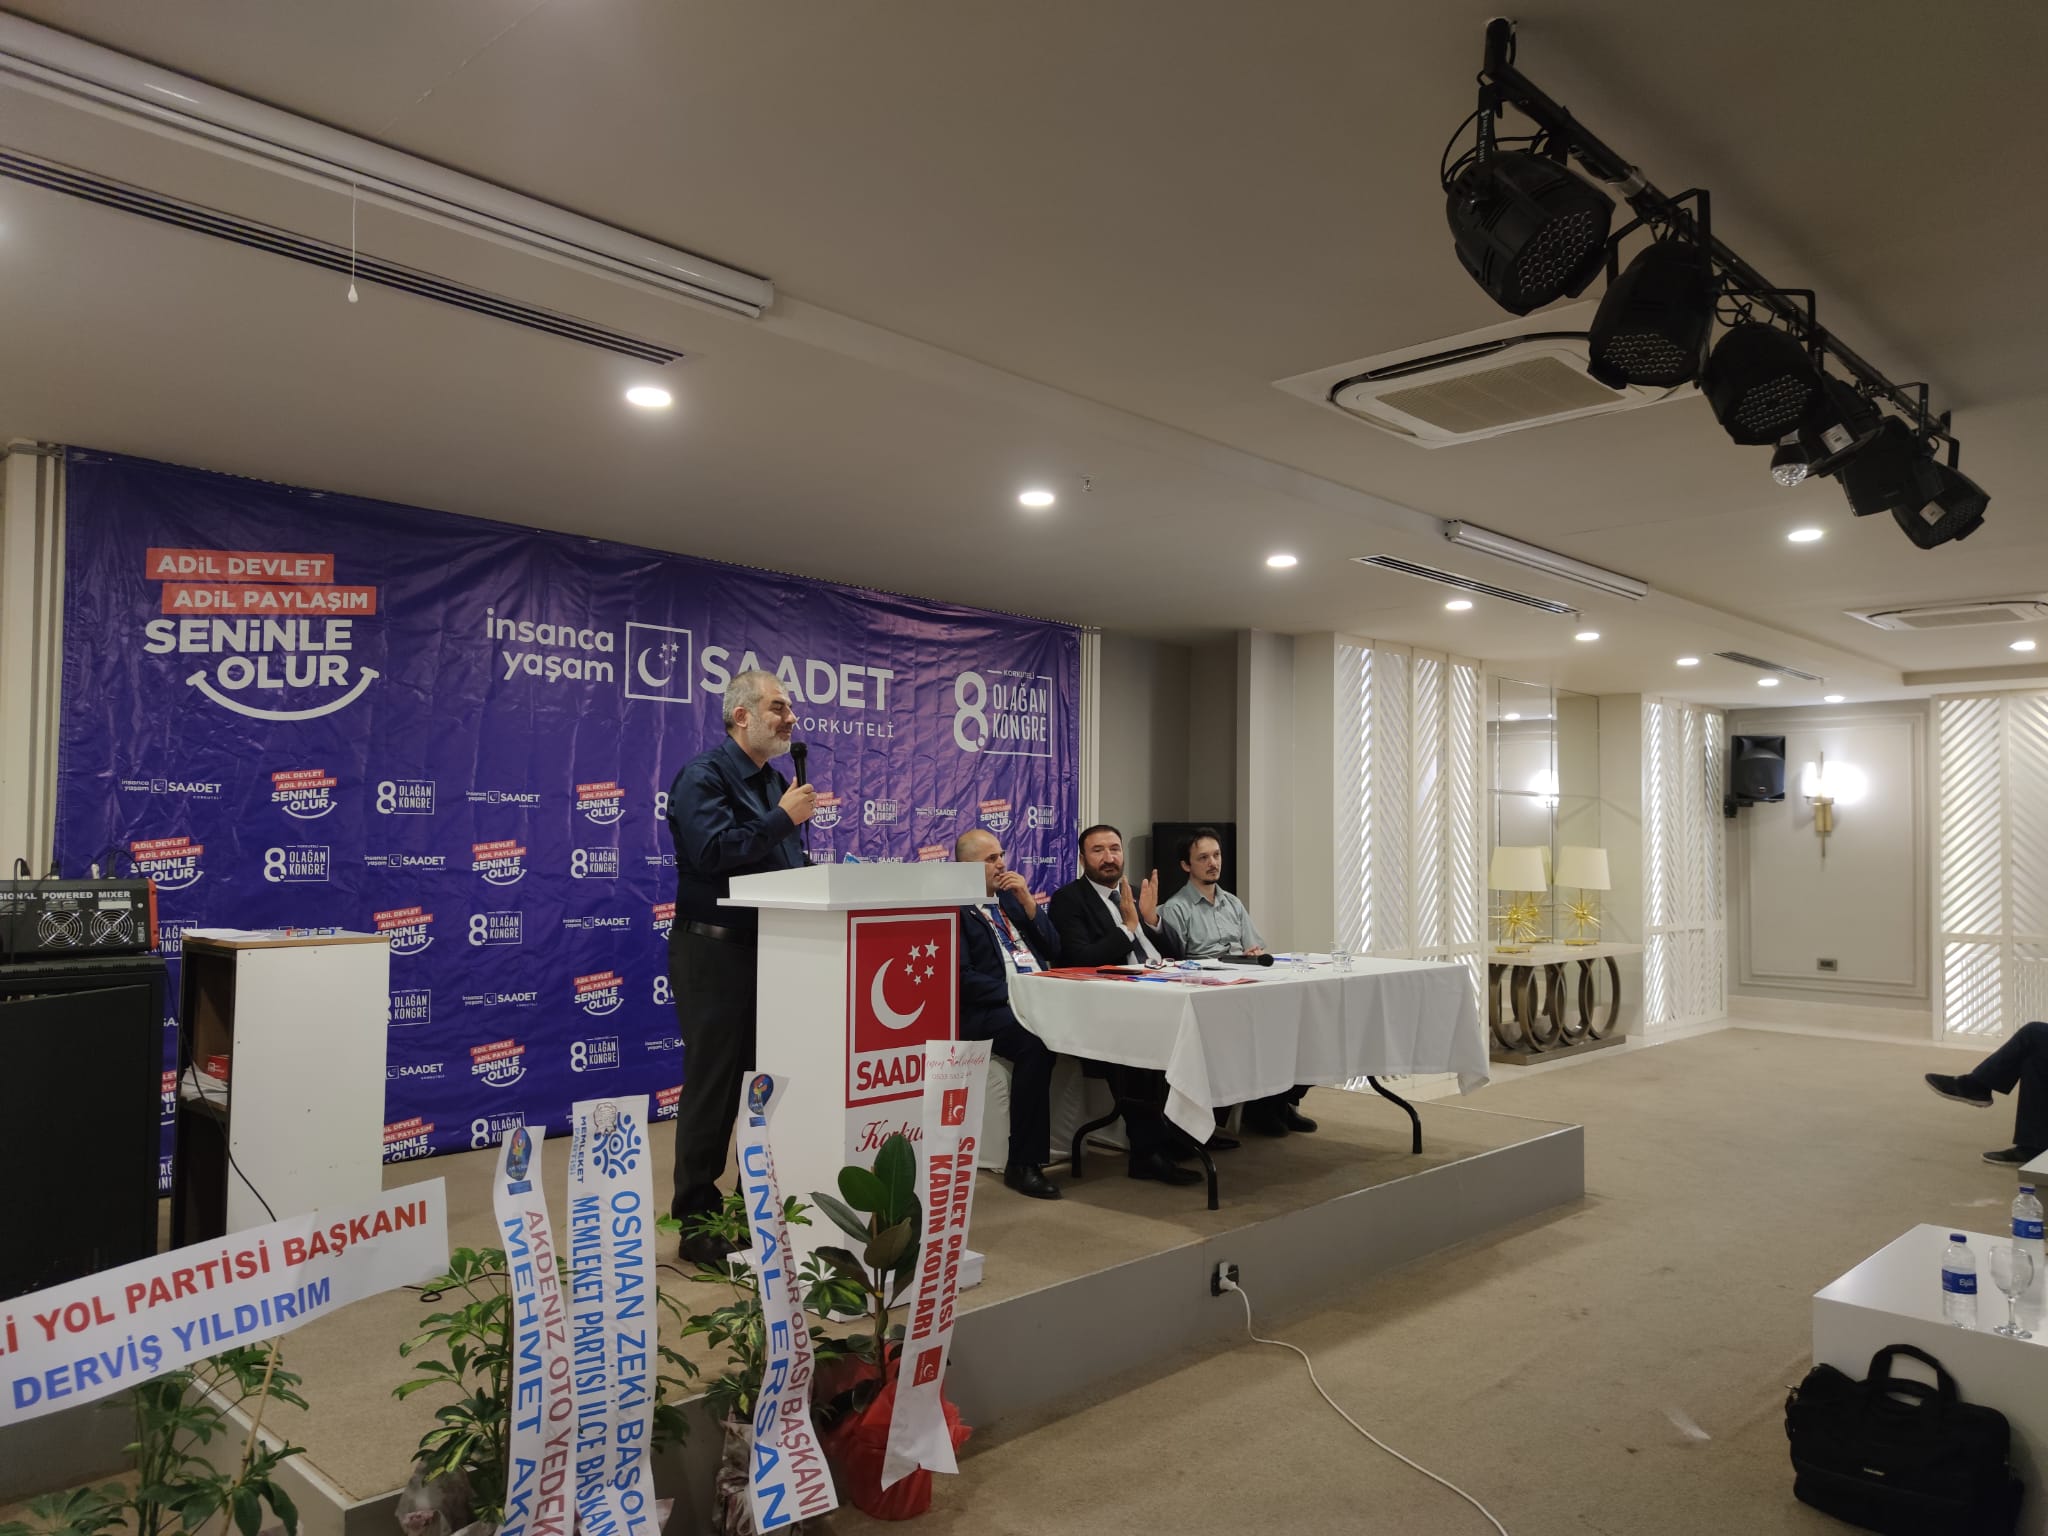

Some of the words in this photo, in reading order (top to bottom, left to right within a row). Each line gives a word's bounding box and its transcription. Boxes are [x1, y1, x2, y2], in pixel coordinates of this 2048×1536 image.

[228, 556, 326, 577] DEVLET
[243, 591, 368, 611] PAYLAŞIM
[486, 608, 614, 653] insanca
[217, 656, 350, 689] OLUR
[502, 650, 614, 683] yaşam
[993, 683, 1046, 713] OLAĞAN
[992, 713, 1046, 741] KONGRE
[168, 782, 221, 793] SAADET
[399, 784, 432, 797] OLAĞAN
[290, 799, 328, 811] OLUR
[399, 797, 431, 809] KONGRE
[500, 793, 540, 802] SAADET
[591, 807, 619, 818] OLUR
[815, 814, 837, 823] OLUR
[289, 849, 326, 863] OLAĞAN
[402, 856, 446, 866] SAADET
[152, 868, 194, 882] OLUR
[289, 863, 326, 876] KONGRE
[488, 866, 520, 879] OLUR
[490, 915, 519, 928] OLAĞAN
[594, 918, 630, 927] SAADET
[159, 925, 193, 940] LAĞ
[391, 934, 425, 948] OLUR
[489, 928, 519, 939] KONGRE
[394, 994, 427, 1008] OLAĞAN
[497, 992, 537, 1003] SAADET
[588, 997, 617, 1010] OLUR
[394, 1007, 427, 1019] KONGRE
[589, 1041, 616, 1054] OLAĞAN
[589, 1052, 616, 1065] KONGRE
[400, 1063, 444, 1076] SAADET
[487, 1067, 519, 1081] OLUR
[856, 1053, 925, 1092] SAAD
[391, 1145, 427, 1162] OLUR
[576, 1116, 587, 1184] MEMLEKET
[928, 1154, 953, 1235] KADIN
[744, 1145, 781, 1300] ÜNAL
[573, 1196, 603, 1304] MEMLEKET
[611, 1190, 645, 1319] OSMAN
[34, 1296, 115, 1342] YOL
[125, 1240, 270, 1314] PARTİSİ
[283, 1200, 427, 1267] BAŞKANI
[525, 1211, 566, 1349] AKDENİZ
[911, 1239, 943, 1341] KOLLARI
[504, 1217, 542, 1434] MEHMET
[12, 1333, 163, 1410] DERVİŞ
[173, 1277, 330, 1353] YILDIRIM
[789, 1312, 811, 1392] ODASI
[573, 1311, 615, 1396] PARTİSİ
[617, 1330, 651, 1410] ZEKİ
[549, 1356, 573, 1422] OTO
[754, 1319, 791, 1529] ERSAN
[776, 1399, 830, 1515] BAŞKANI
[531, 1427, 572, 1536] YEDEK
[607, 1419, 647, 1536] BAŞOL
